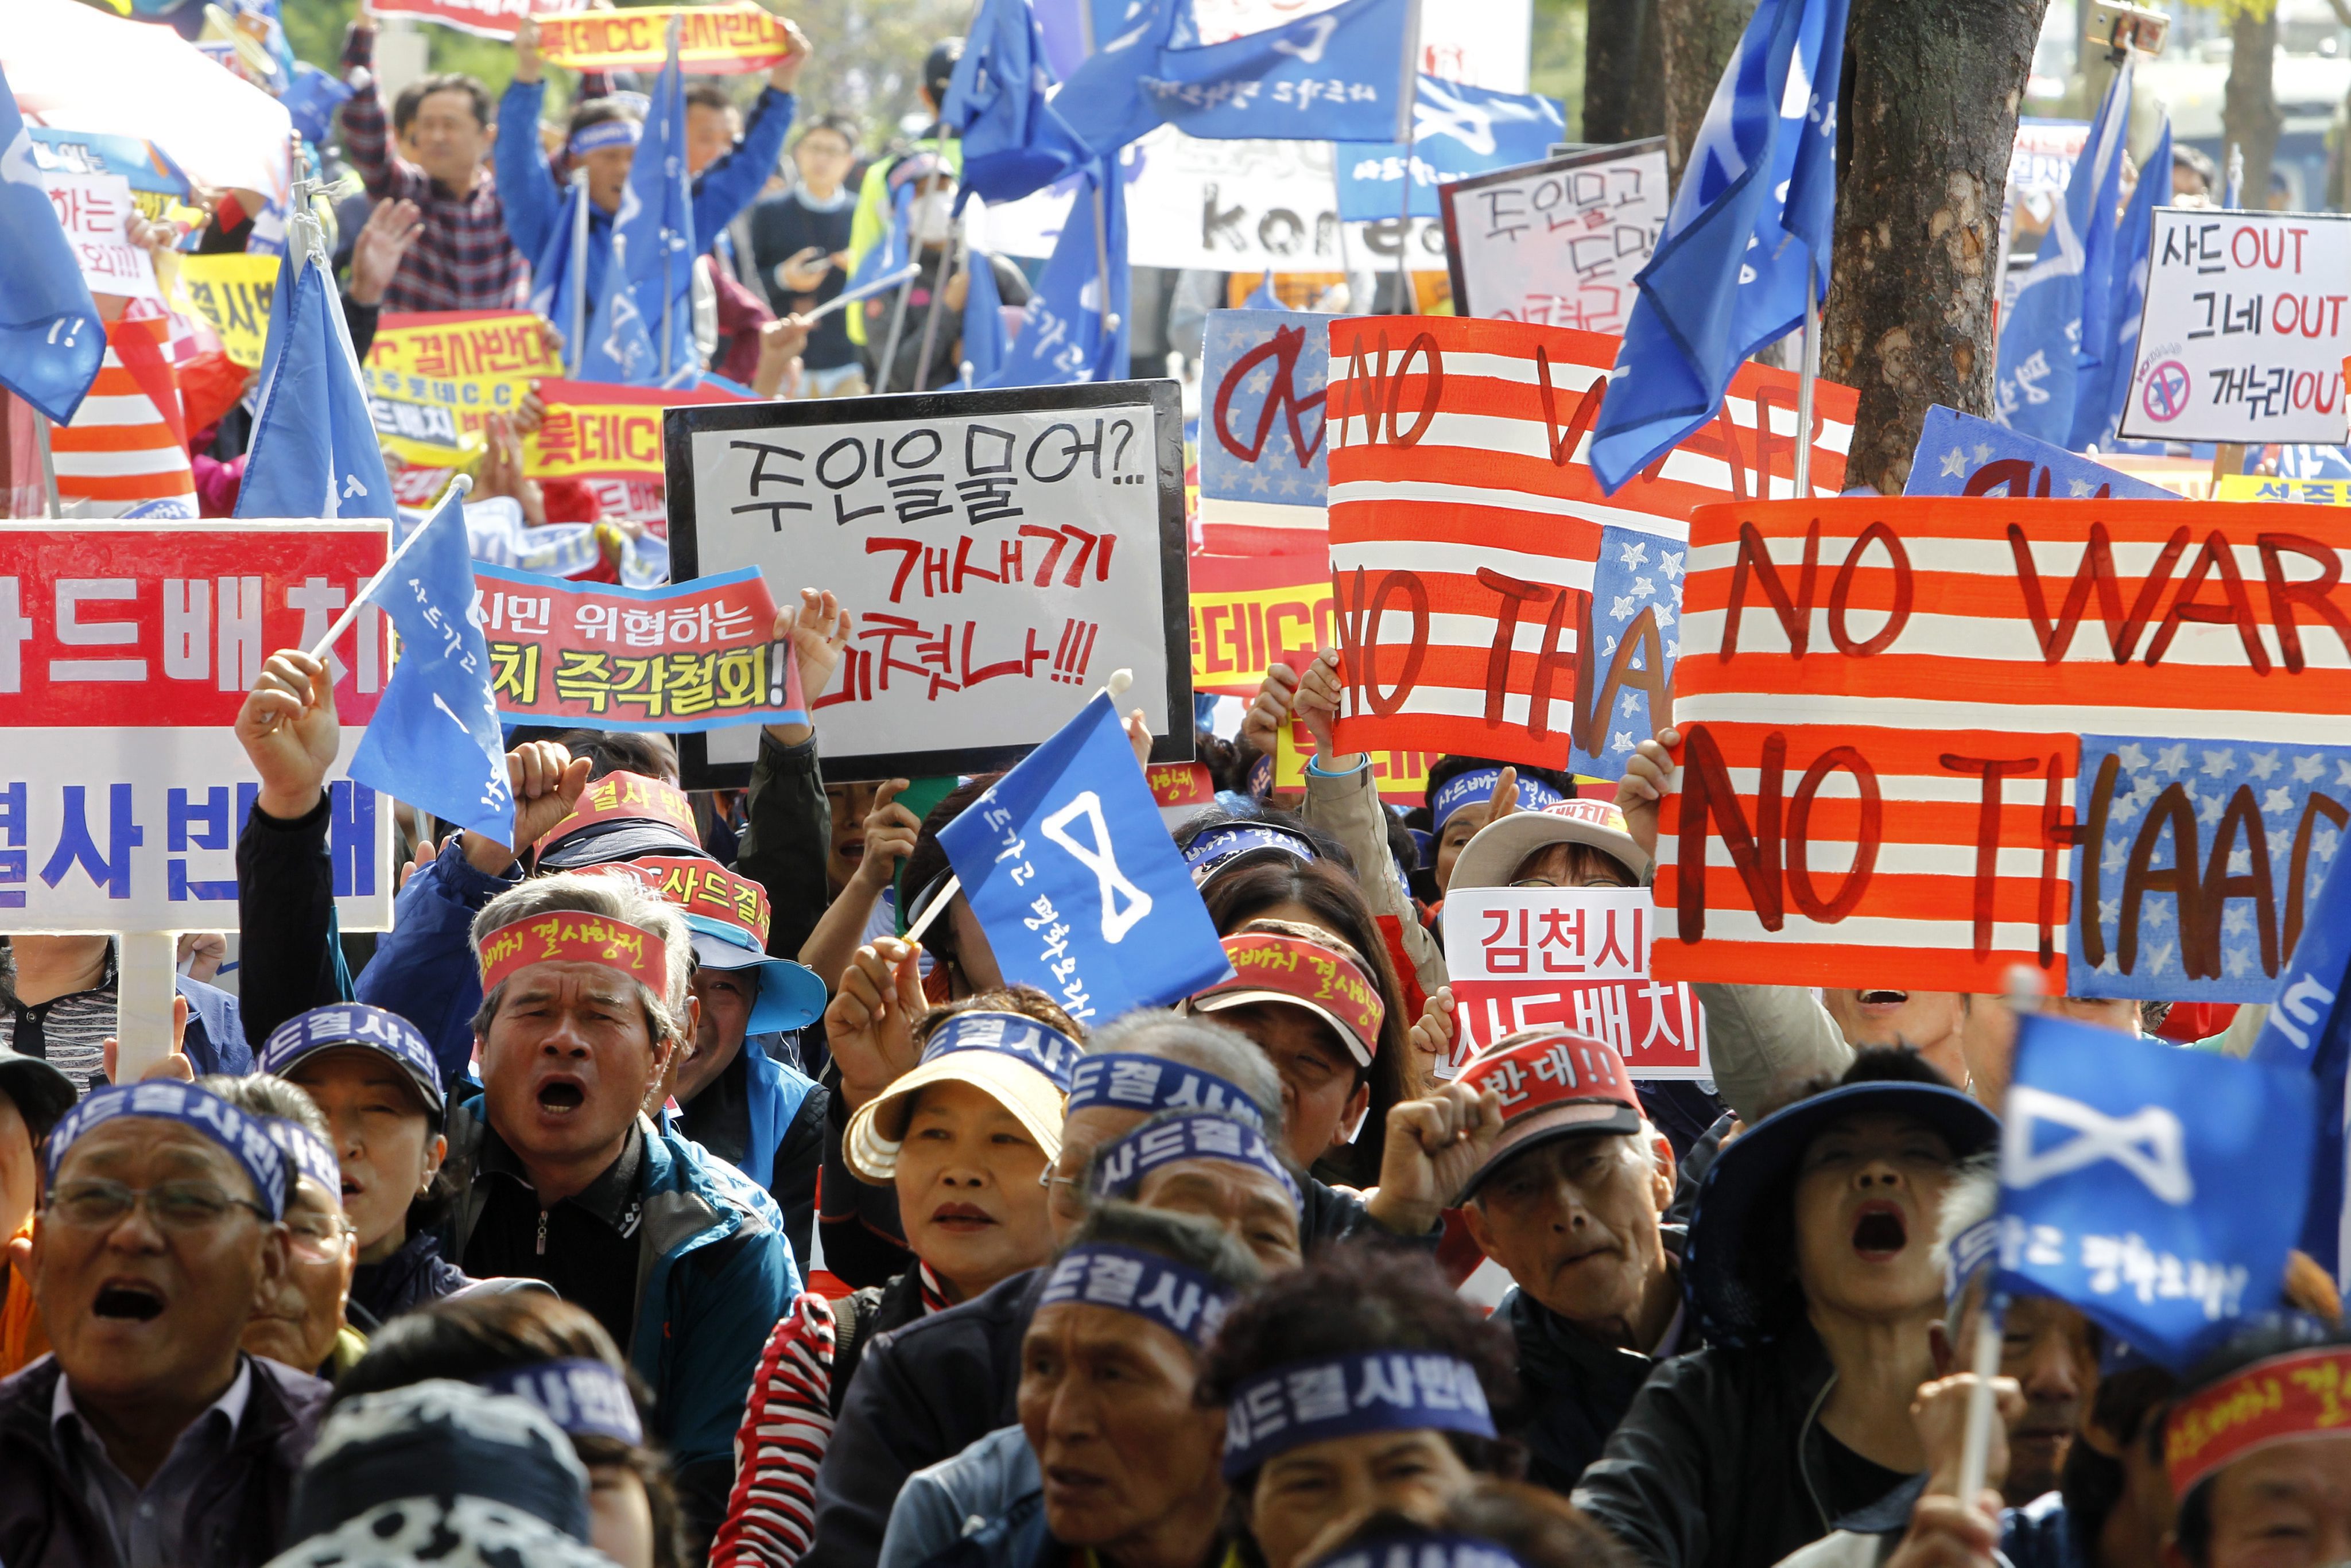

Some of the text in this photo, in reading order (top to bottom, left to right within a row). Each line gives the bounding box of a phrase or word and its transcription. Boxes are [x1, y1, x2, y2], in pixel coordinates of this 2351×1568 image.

[1340, 329, 1444, 450] NO
[2292, 370, 2347, 414] OU
[536, 410, 664, 467] 롯데C
[574, 599, 754, 647] 위협하는
[1719, 517, 2351, 677] NO WAR
[556, 642, 787, 717] 즉각철회!
[1333, 561, 1430, 721] NO
[1476, 566, 1674, 759] THA
[589, 780, 651, 812] 결사
[1678, 724, 1883, 946] NO
[532, 918, 645, 970] 결사항전
[1481, 907, 1644, 974] 김천시
[255, 1011, 443, 1094] 드결사반
[920, 1018, 1078, 1074] 드결사
[1452, 981, 1696, 1068] 사드배치
